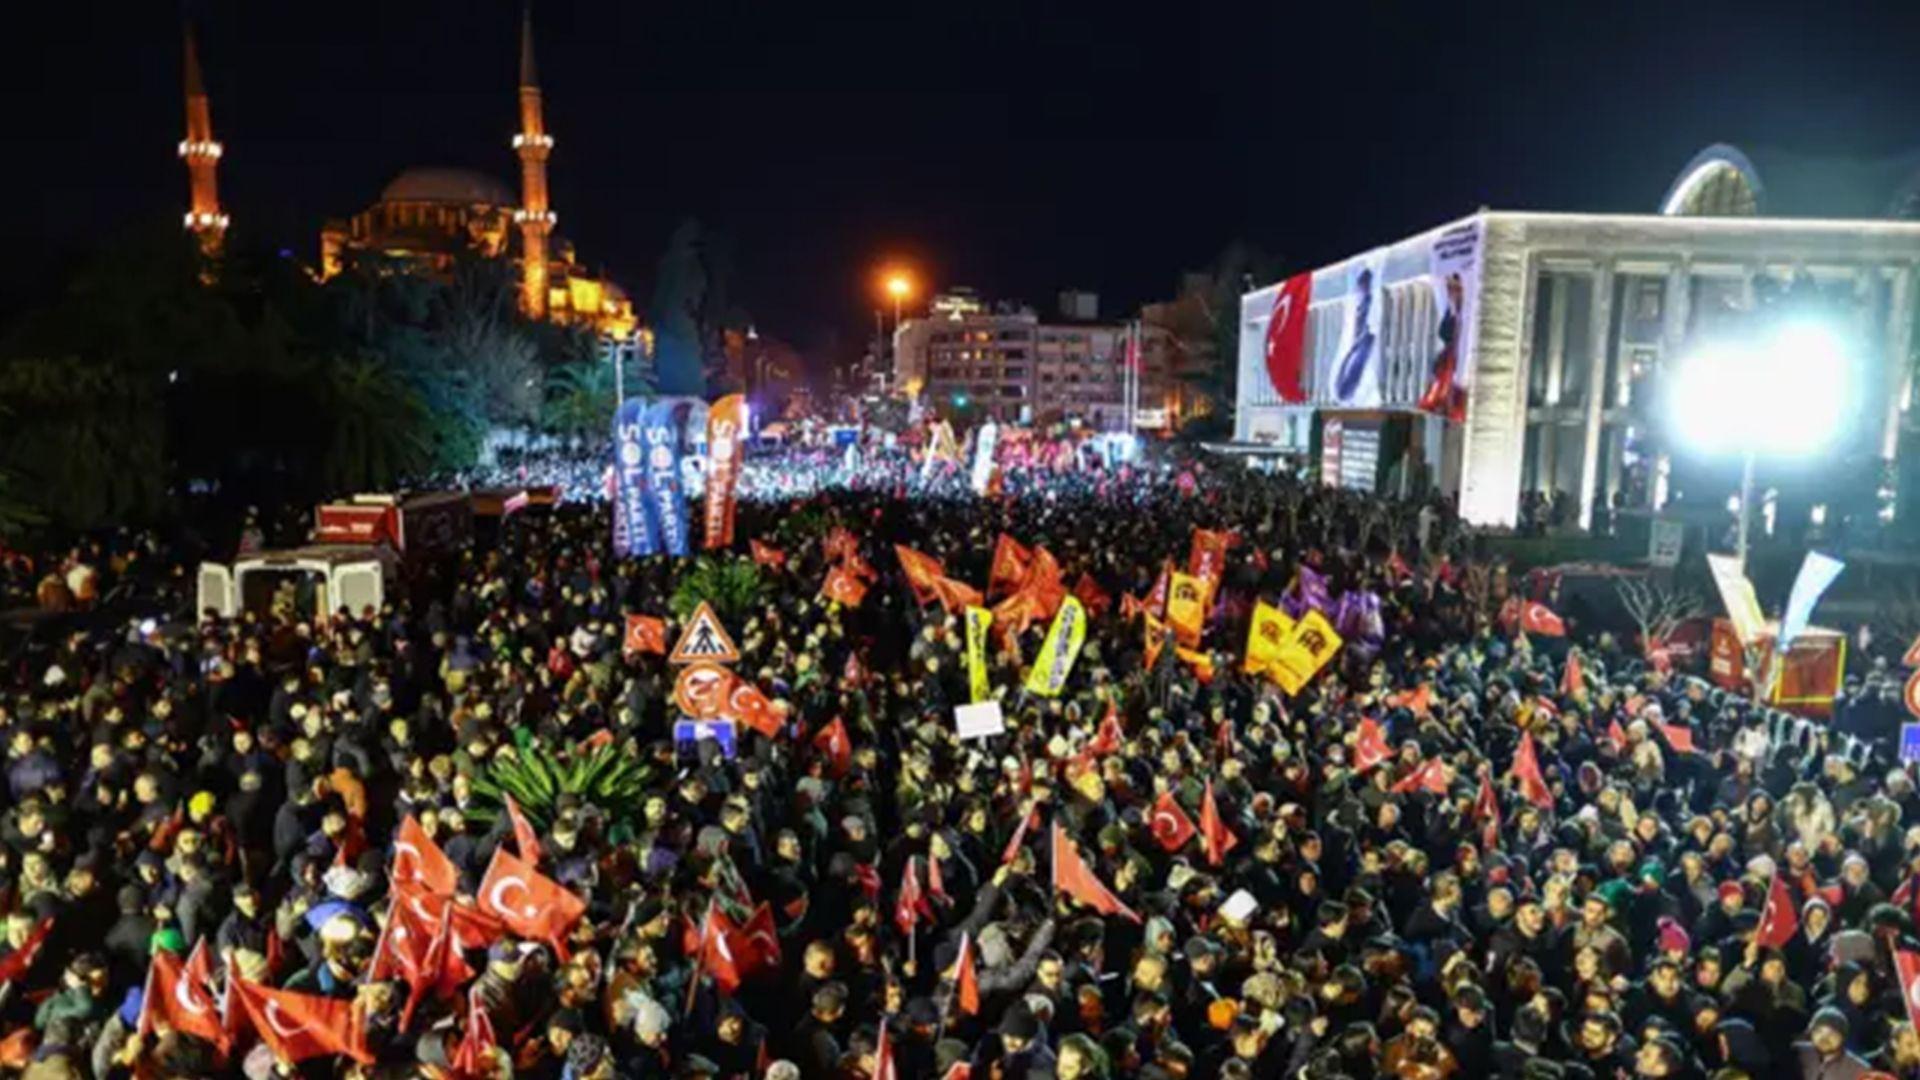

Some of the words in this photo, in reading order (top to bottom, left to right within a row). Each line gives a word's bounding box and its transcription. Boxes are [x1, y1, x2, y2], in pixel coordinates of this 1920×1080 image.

[618, 424, 644, 486] SOL
[646, 426, 675, 488] SOL
[709, 419, 736, 476] SOL
